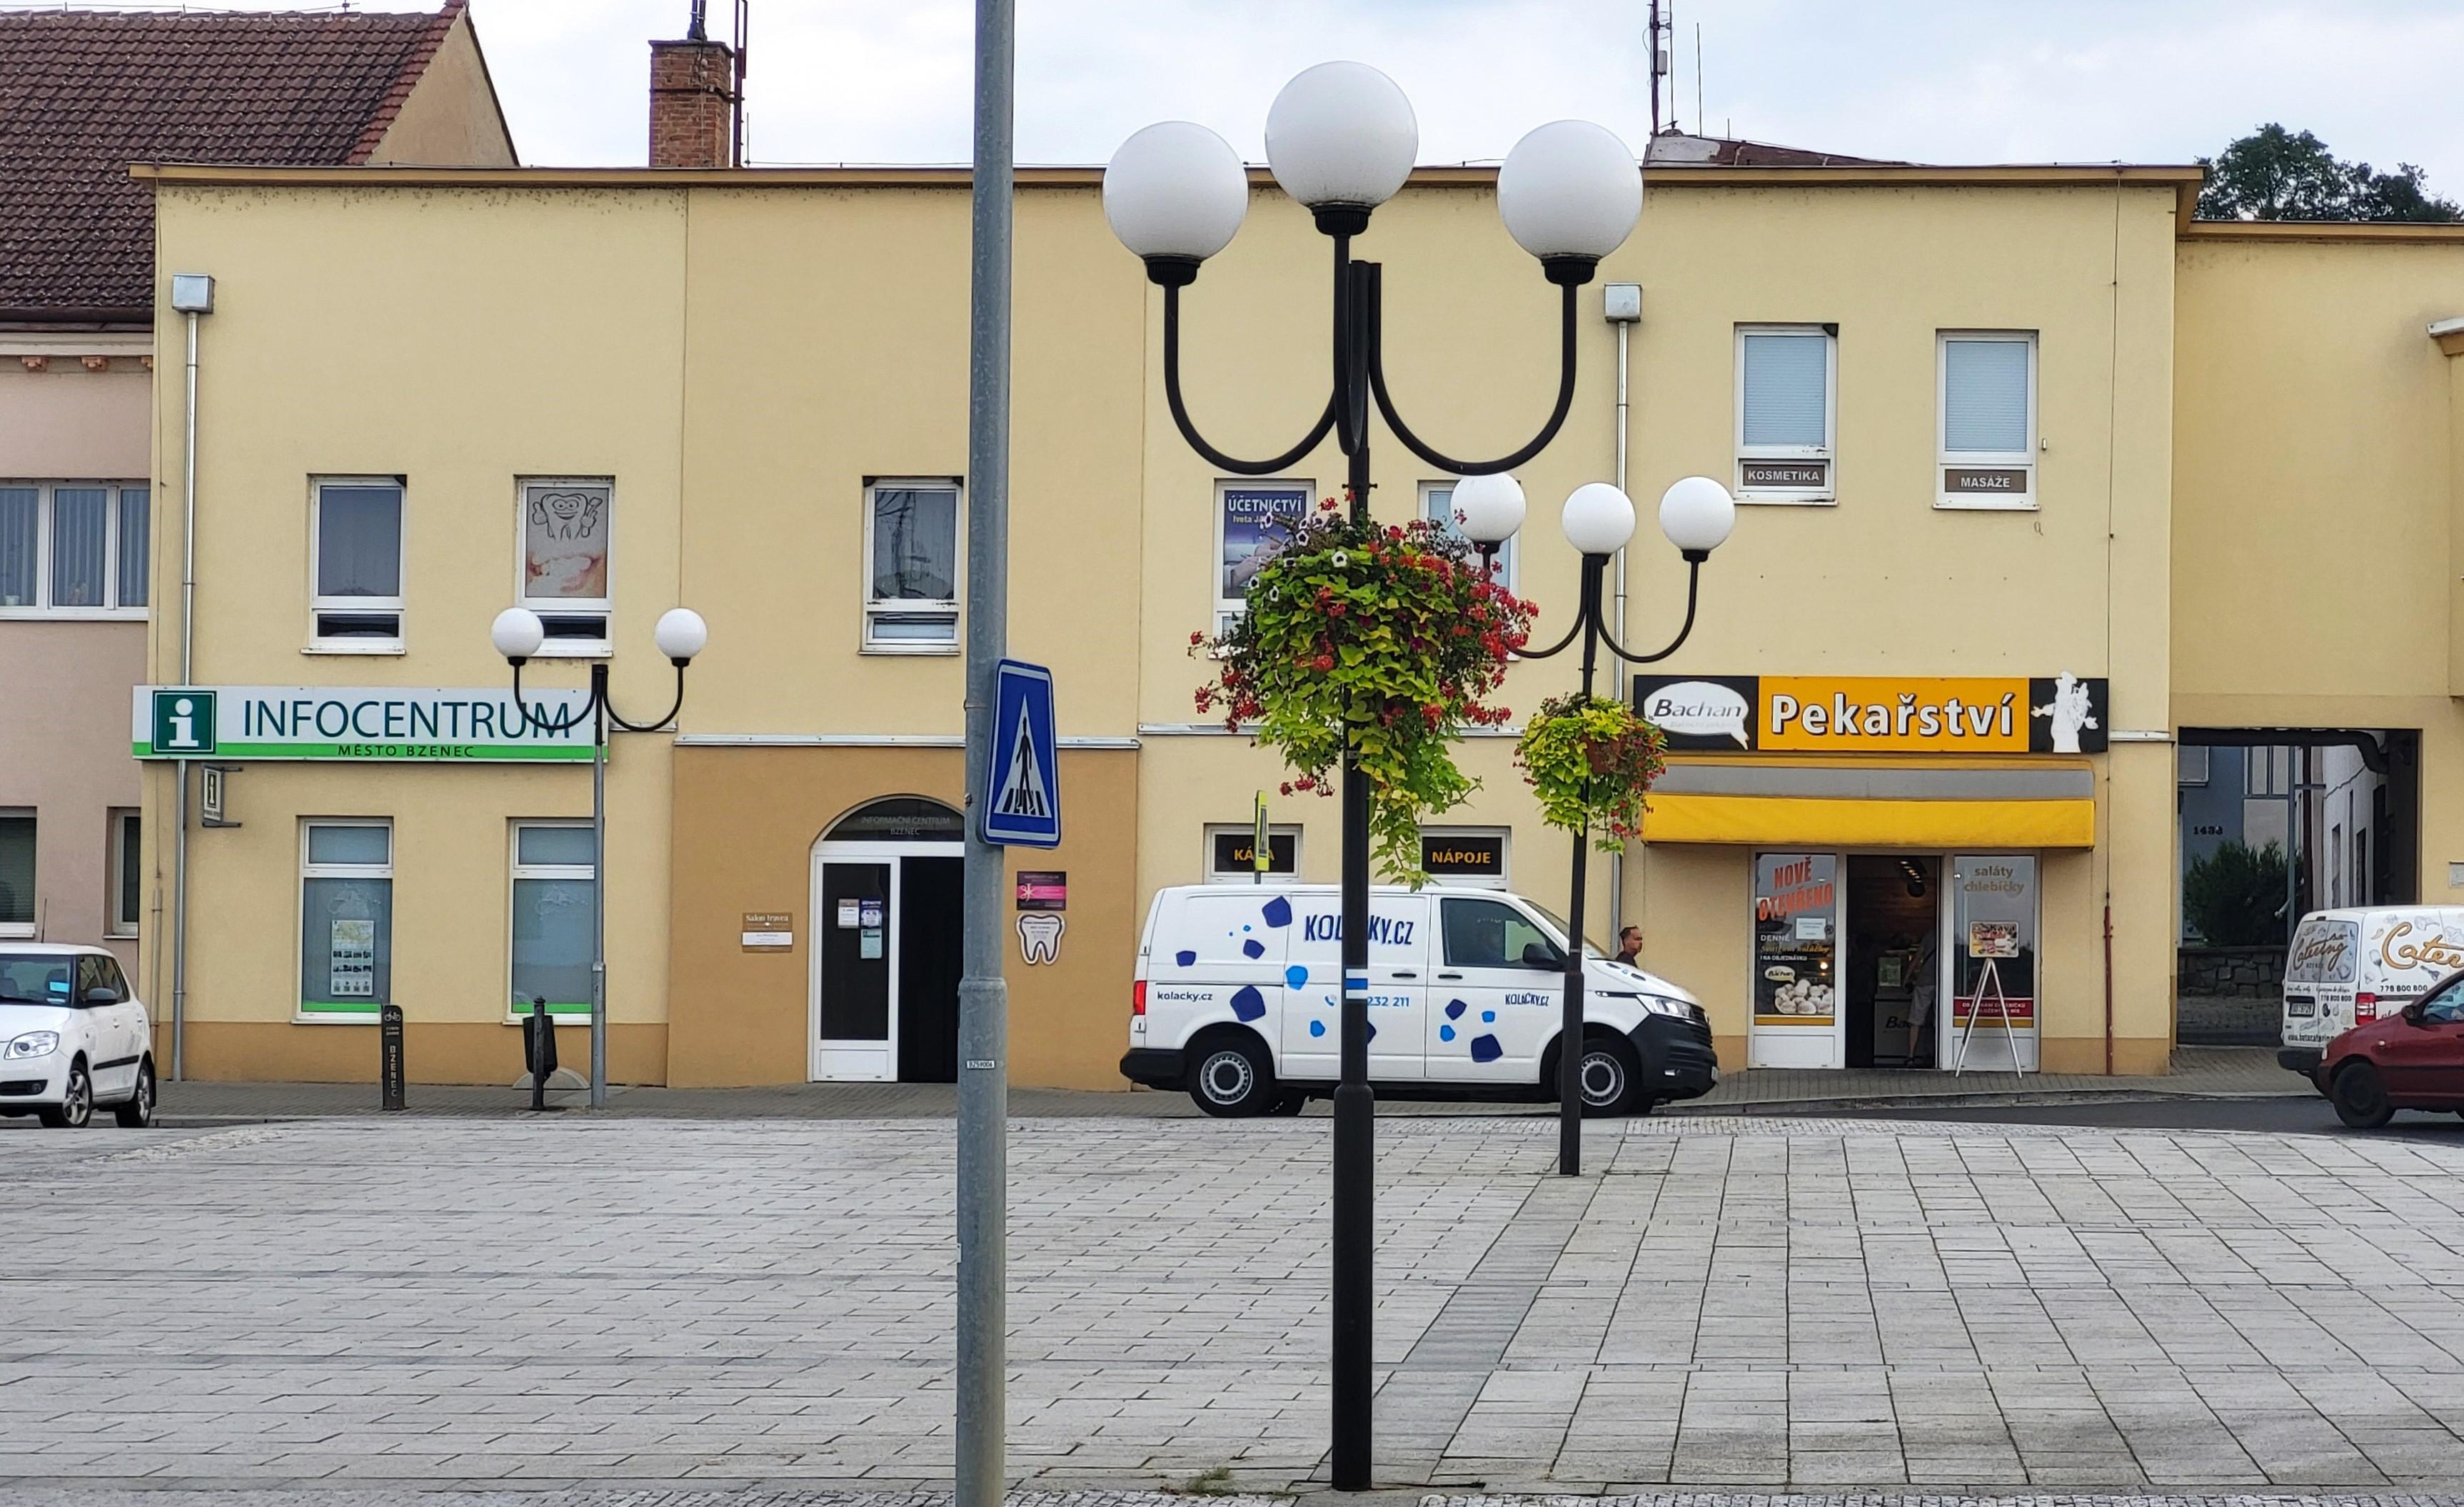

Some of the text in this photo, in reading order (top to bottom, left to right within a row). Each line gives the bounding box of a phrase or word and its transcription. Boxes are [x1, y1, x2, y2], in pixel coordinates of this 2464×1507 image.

[1747, 470, 1820, 481] KOSMETIKA
[1960, 475, 2011, 488] MASÁŽE
[1228, 495, 1303, 513] ÚČETNICTVÍ
[1233, 515, 1252, 523] Iveta
[1654, 699, 1742, 717] Bachan
[1771, 693, 2016, 737] Pekařství
[243, 700, 572, 740] INFOCENTRUM
[338, 744, 475, 757] MĚSTO BZENEC
[1234, 845, 1275, 861] KÁA
[1432, 847, 1492, 863] NÁPOJE
[1774, 856, 1811, 890] NOVĚ
[1974, 865, 2013, 879] saláty
[1304, 914, 1414, 945] KOLKY.CZ
[1157, 991, 1213, 1002] kolacky.cz
[1367, 996, 1409, 1007] 232 211
[389, 1045, 398, 1097] BZENEC
